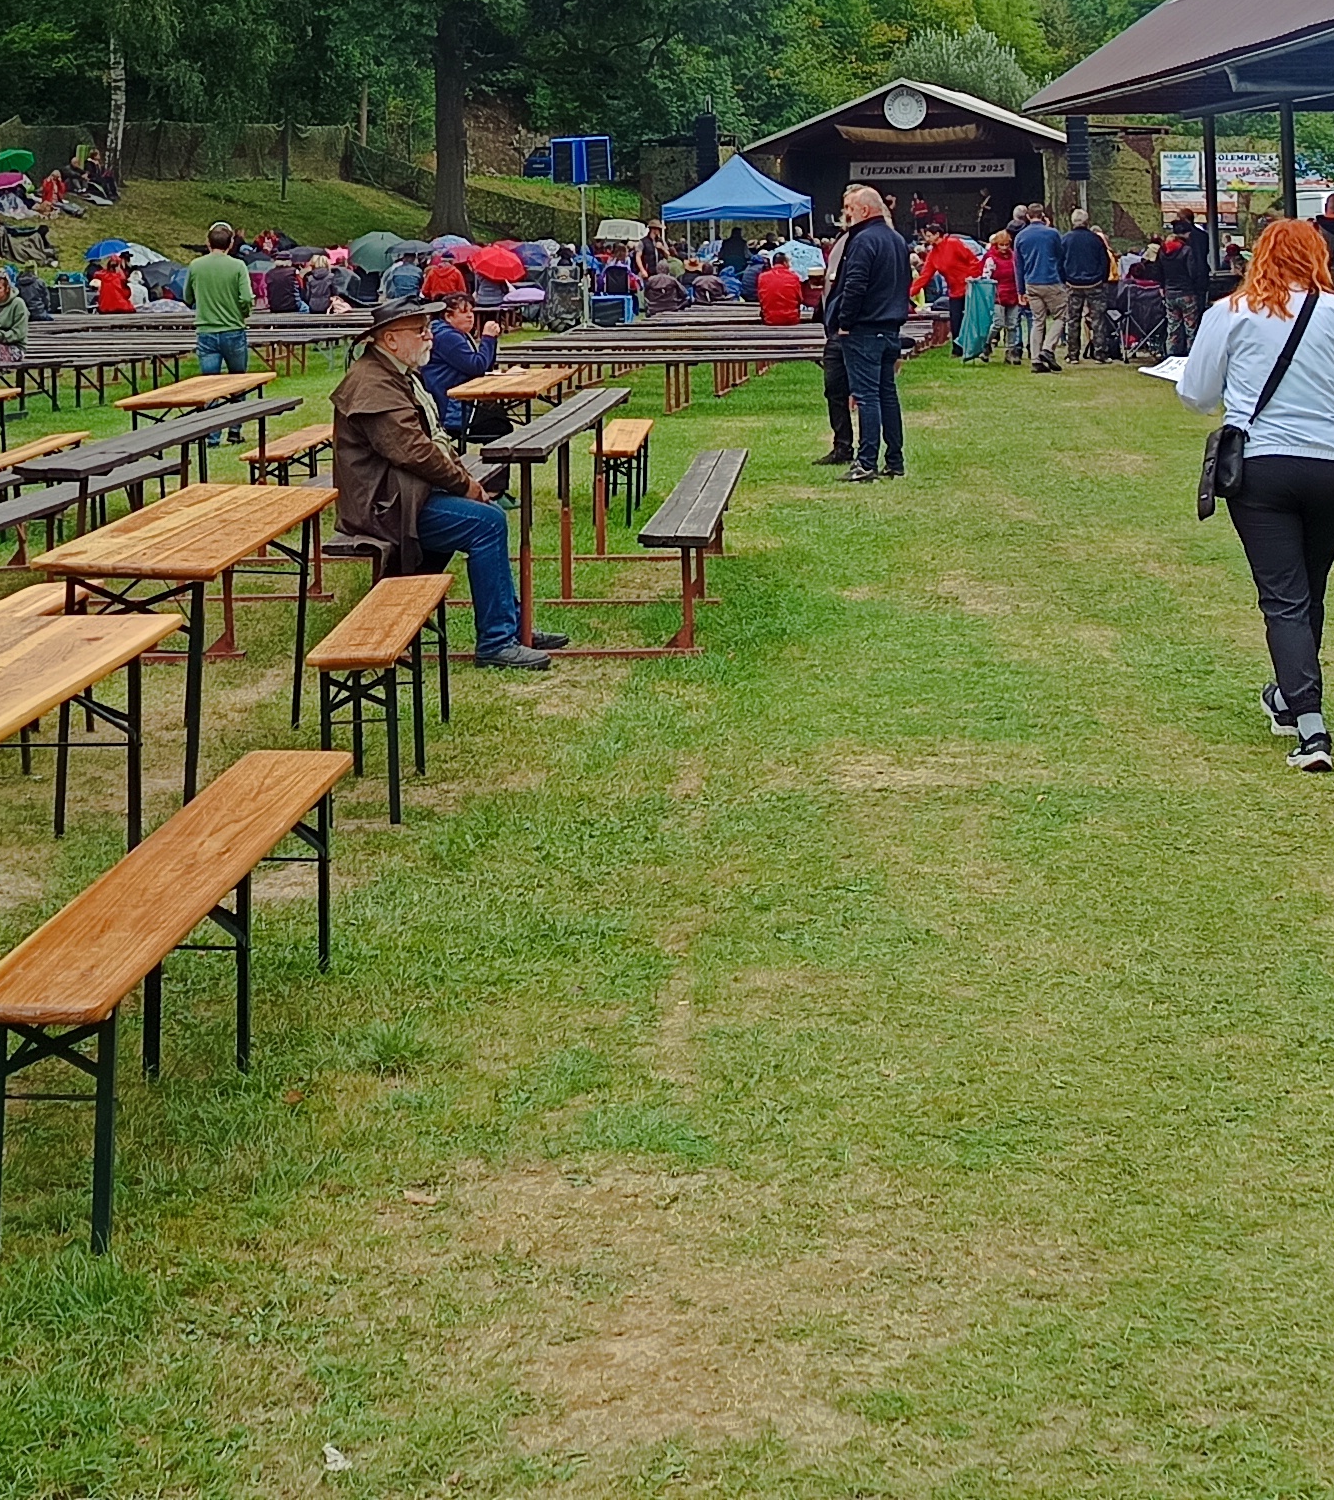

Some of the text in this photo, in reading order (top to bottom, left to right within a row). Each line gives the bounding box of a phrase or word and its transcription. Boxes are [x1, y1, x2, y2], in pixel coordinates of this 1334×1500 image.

[860, 164, 914, 176] ÚJEZDSKÉ
[917, 163, 946, 174] BABÍ
[948, 162, 976, 173] LÉTO
